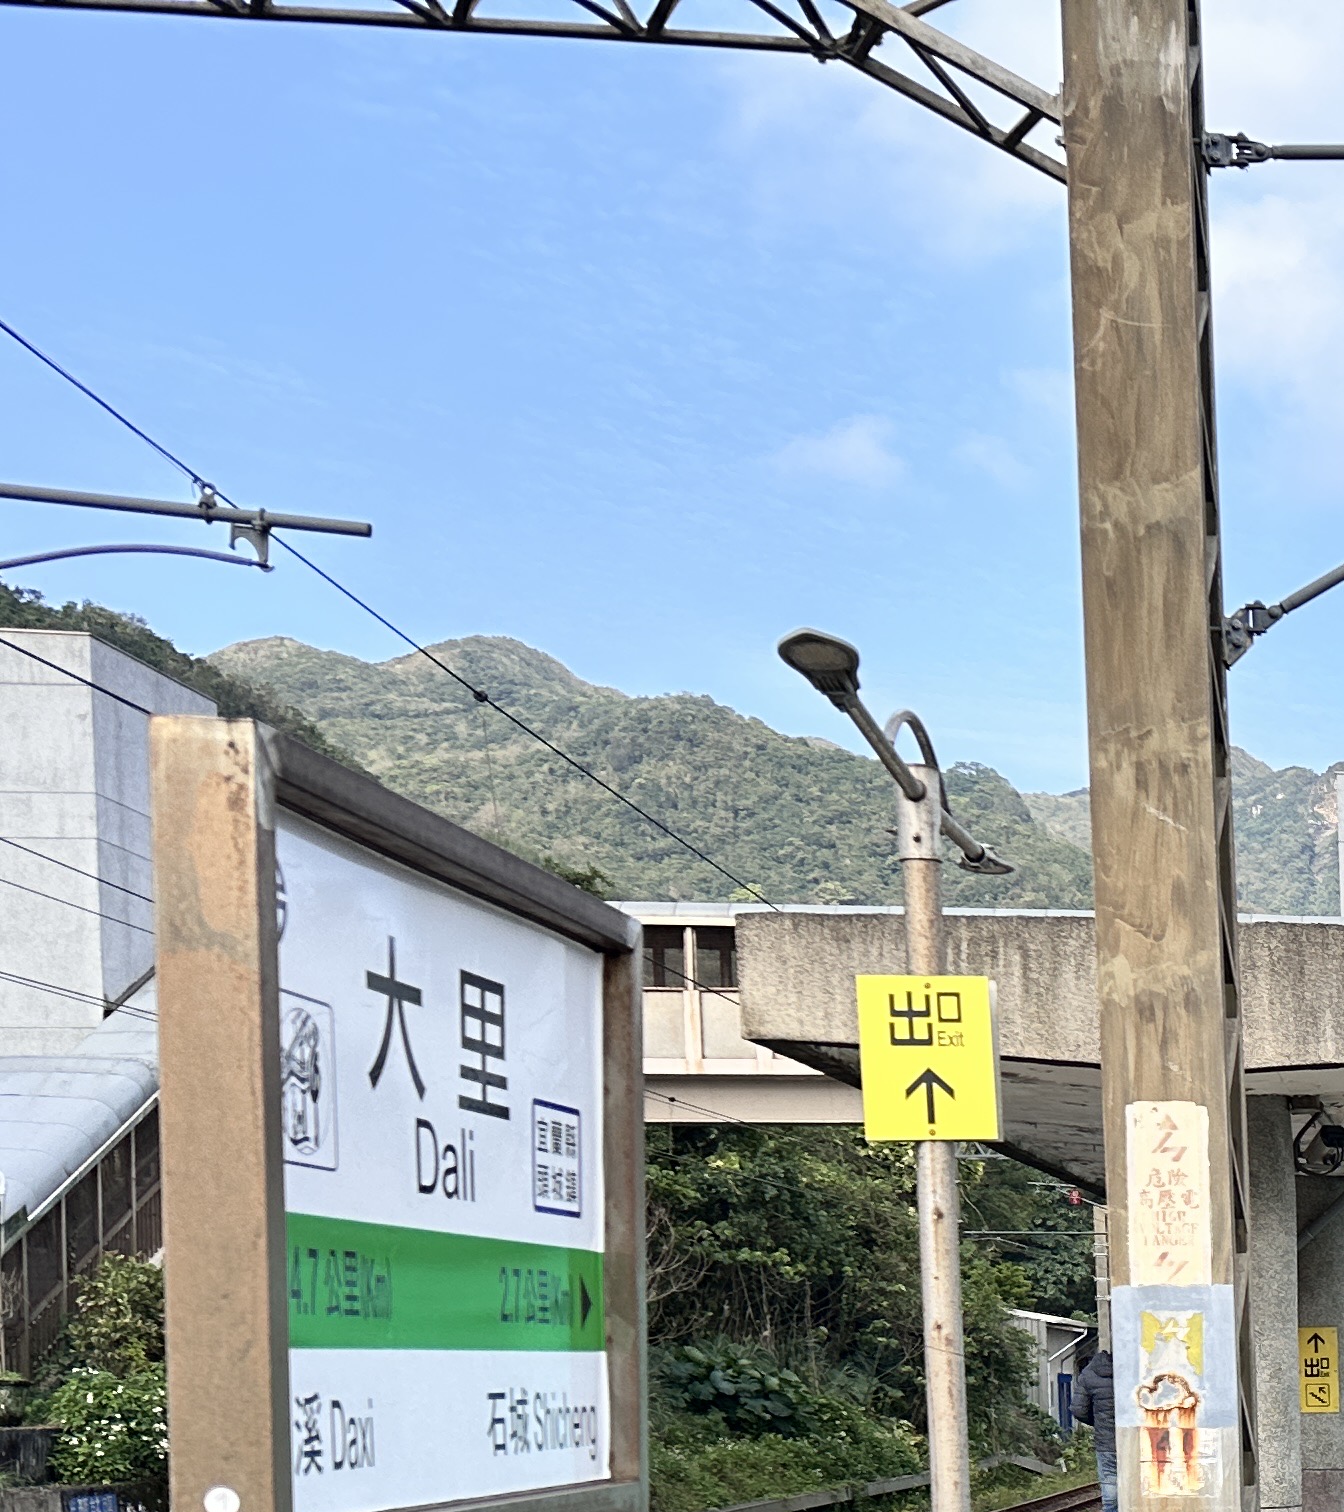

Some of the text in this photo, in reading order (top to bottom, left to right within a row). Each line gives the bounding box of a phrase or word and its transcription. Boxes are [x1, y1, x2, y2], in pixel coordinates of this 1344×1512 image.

[366, 935, 510, 1120] 大里
[888, 990, 962, 1046] 出口
[937, 1030, 965, 1047] Exit
[415, 1117, 477, 1202] Dali
[1303, 1357, 1330, 1378] 出口
[330, 1397, 376, 1472] Daxi
[487, 1387, 597, 1461] 石城 Shicheng
